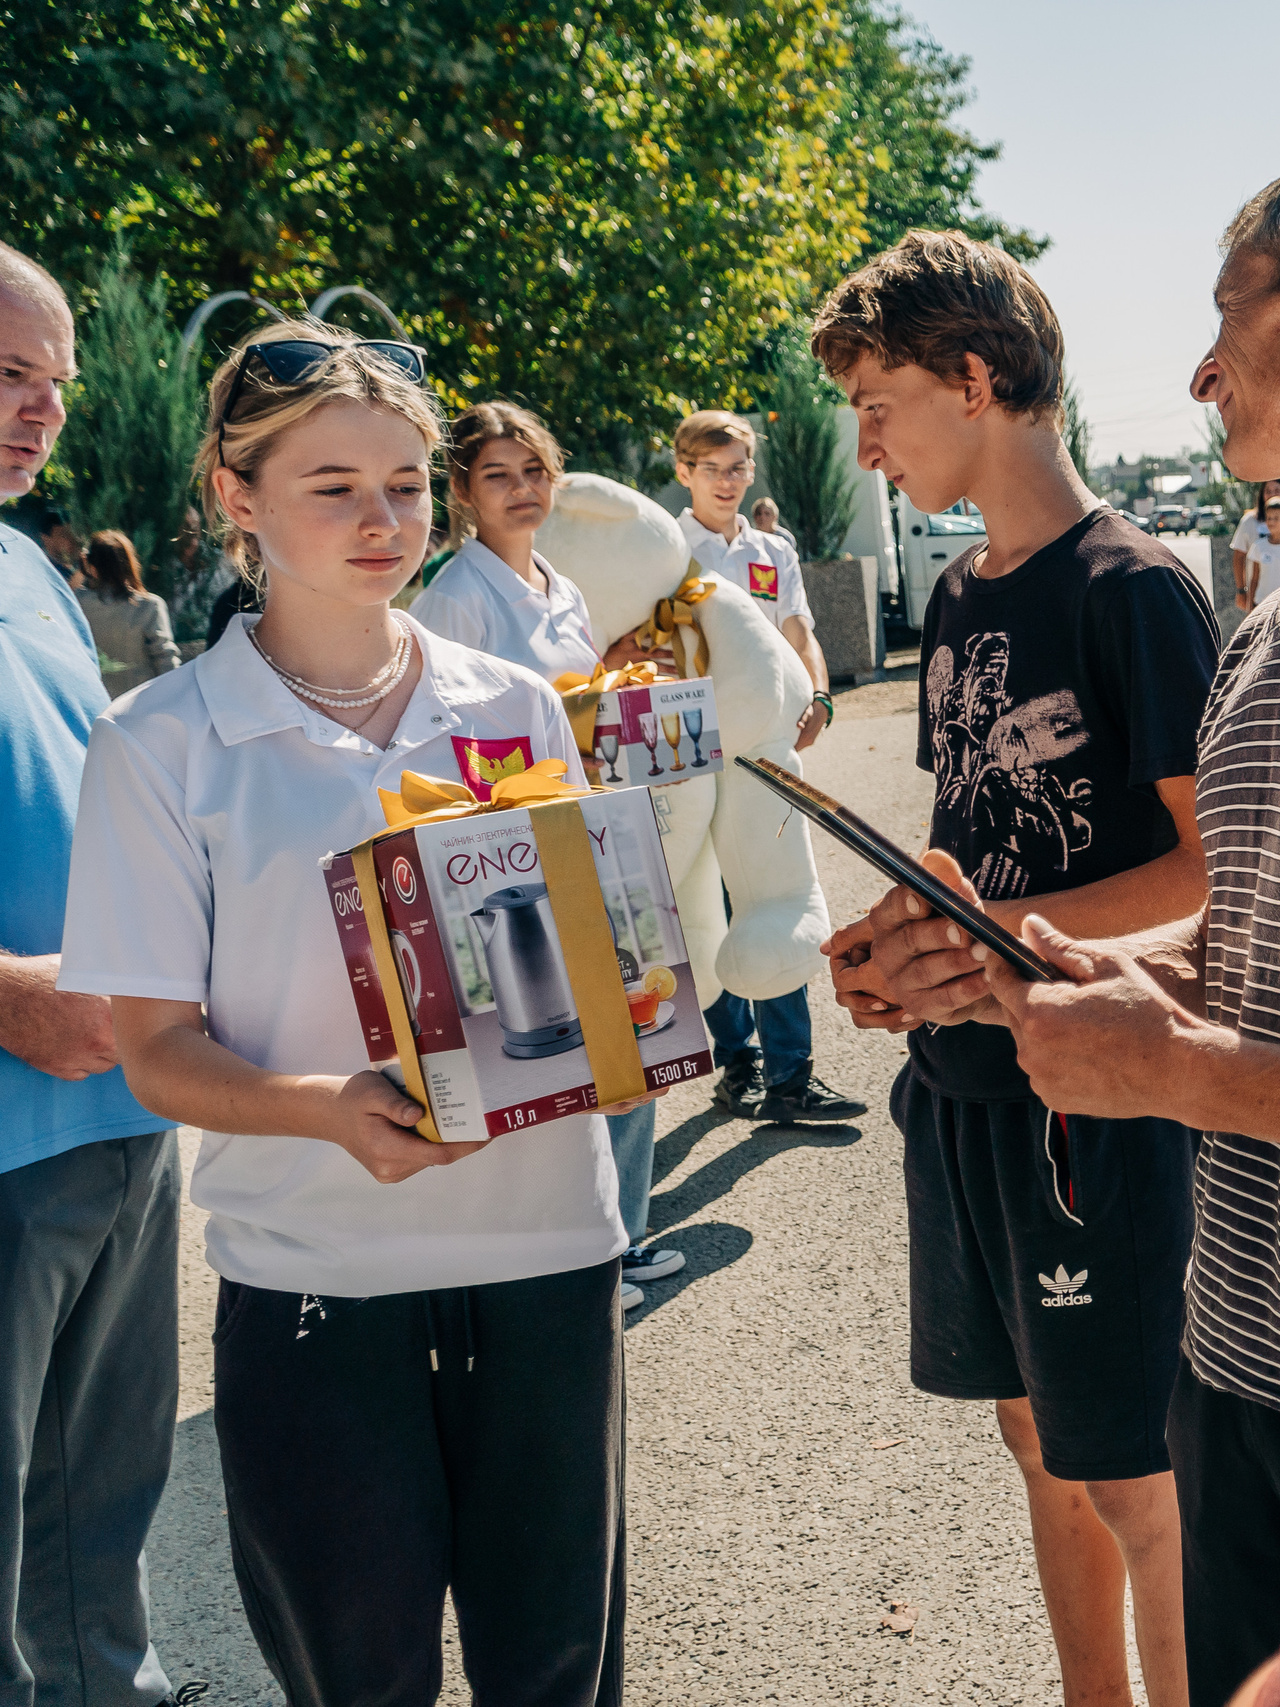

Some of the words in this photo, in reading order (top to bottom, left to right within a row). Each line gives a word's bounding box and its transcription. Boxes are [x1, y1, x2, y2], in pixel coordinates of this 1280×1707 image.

[660, 692, 683, 703] GLASS
[440, 836, 475, 848] ЧАЙНИК
[476, 824, 534, 843] ЭЛЕКТРИЧЕСКИ
[446, 826, 607, 885] eNeY
[334, 877, 388, 917] eNeY
[652, 1063, 681, 1085] 1500
[683, 1060, 698, 1077] Вт
[503, 1109, 525, 1129] 1,8
[527, 1109, 537, 1123] л
[1041, 1293, 1093, 1308] adidas
